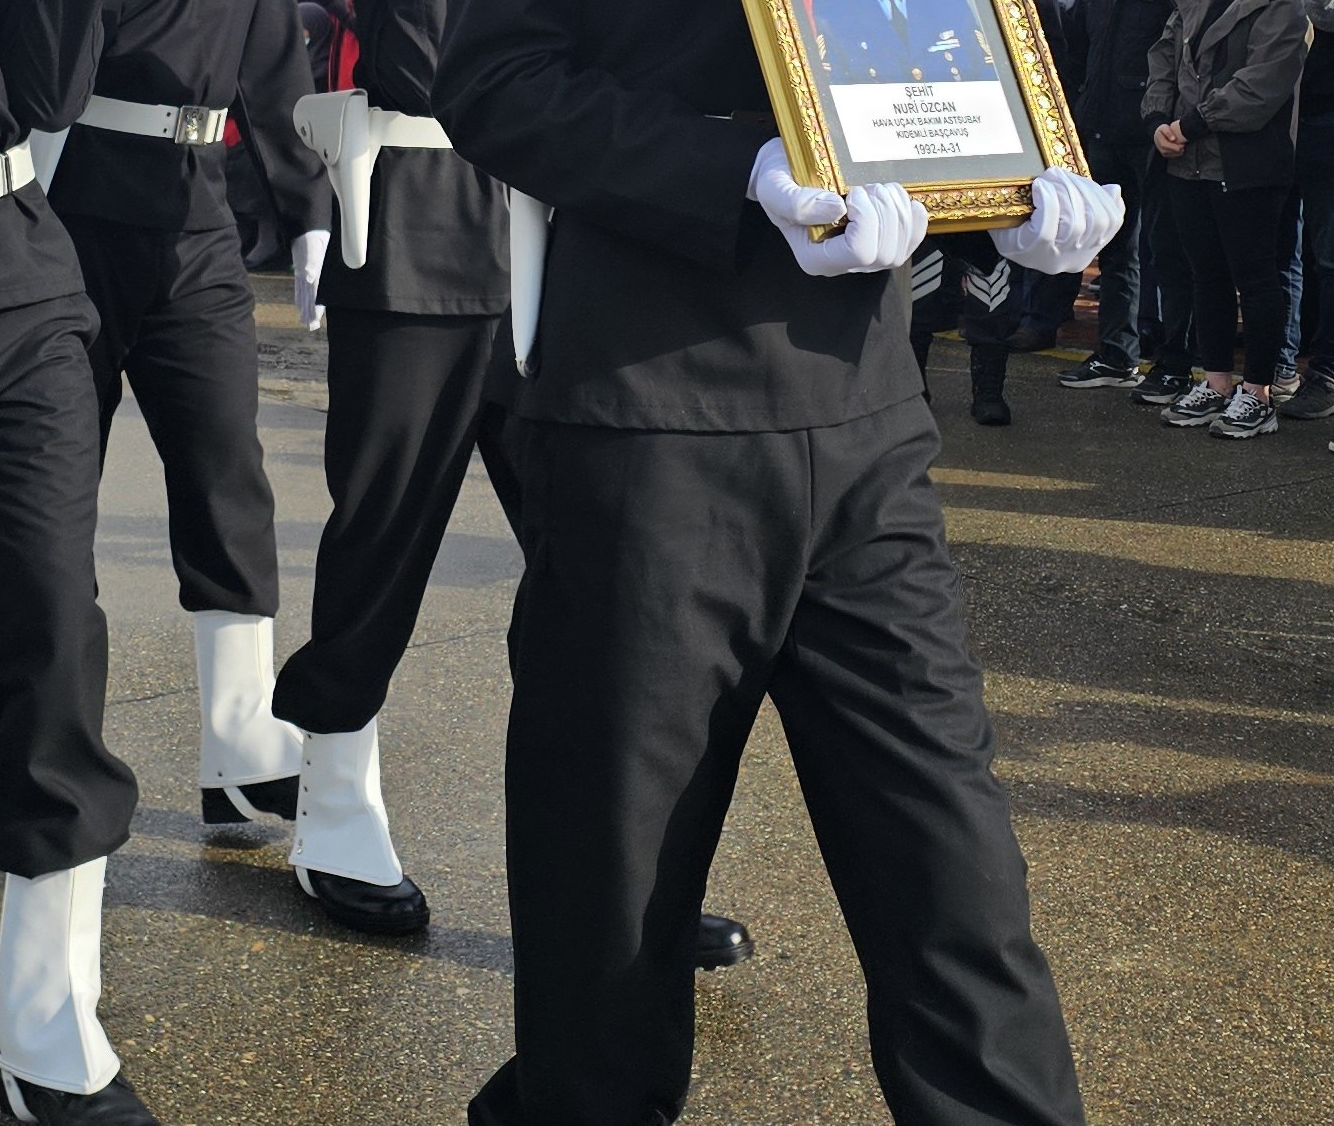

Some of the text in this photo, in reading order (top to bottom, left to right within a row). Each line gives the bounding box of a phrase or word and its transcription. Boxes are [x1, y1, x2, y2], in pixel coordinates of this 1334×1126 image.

[904, 84, 934, 100] ŞEHİT
[893, 100, 957, 115] NURİ ÖZCAN
[872, 115, 982, 129] HAVA UÇAK BAKIM ASTSUBAY
[896, 127, 969, 139] KIDEMLİ BAŞÇAVUŞ
[913, 142, 961, 155] 1992-A-31
